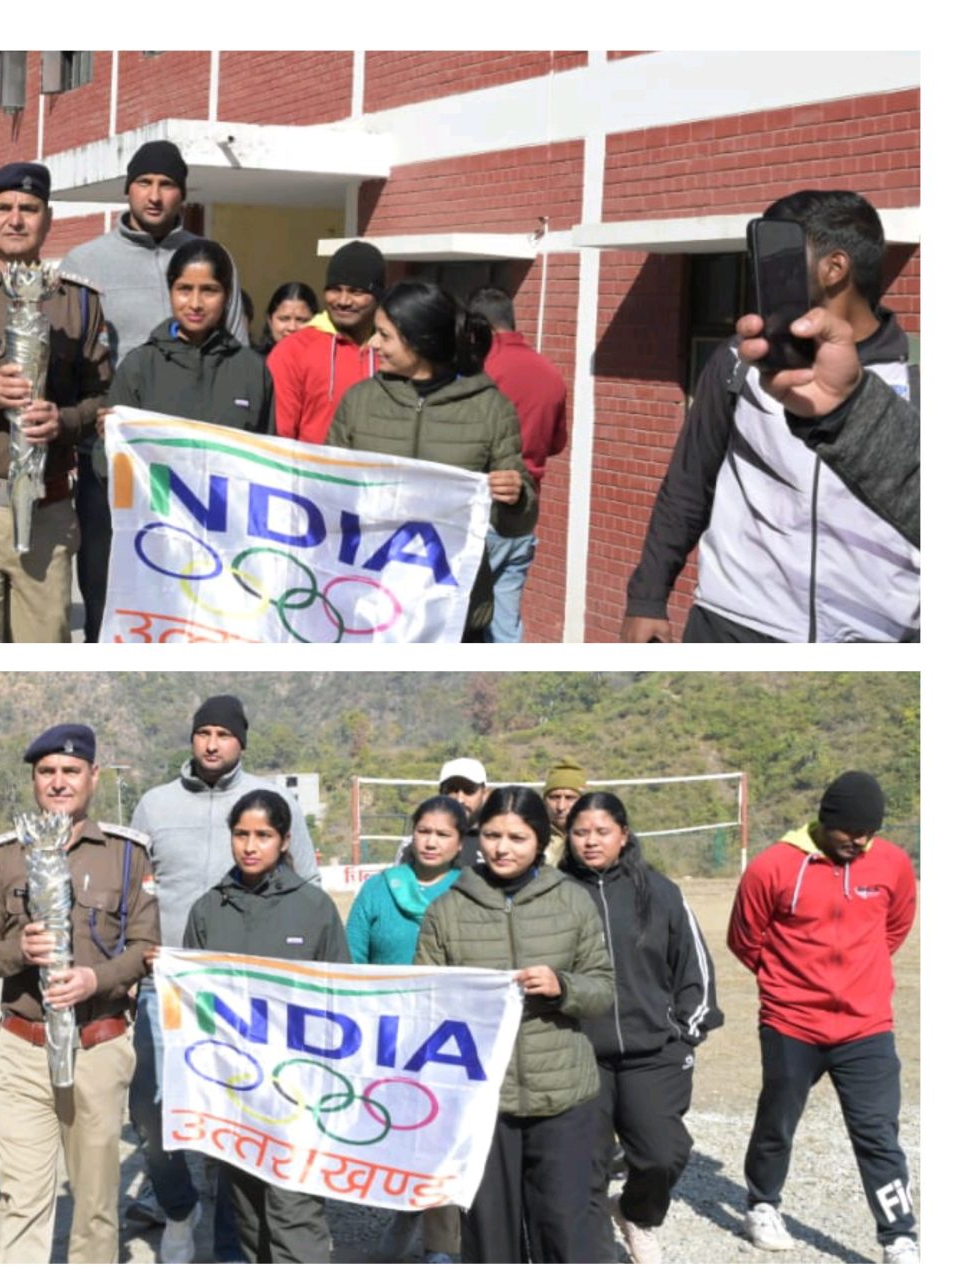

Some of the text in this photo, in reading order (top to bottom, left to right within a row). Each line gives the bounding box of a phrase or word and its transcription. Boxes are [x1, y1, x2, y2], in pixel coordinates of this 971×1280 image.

[113, 452, 460, 587] INDIA
[163, 984, 488, 1082] INDIA
[875, 1178, 912, 1223] Fi
